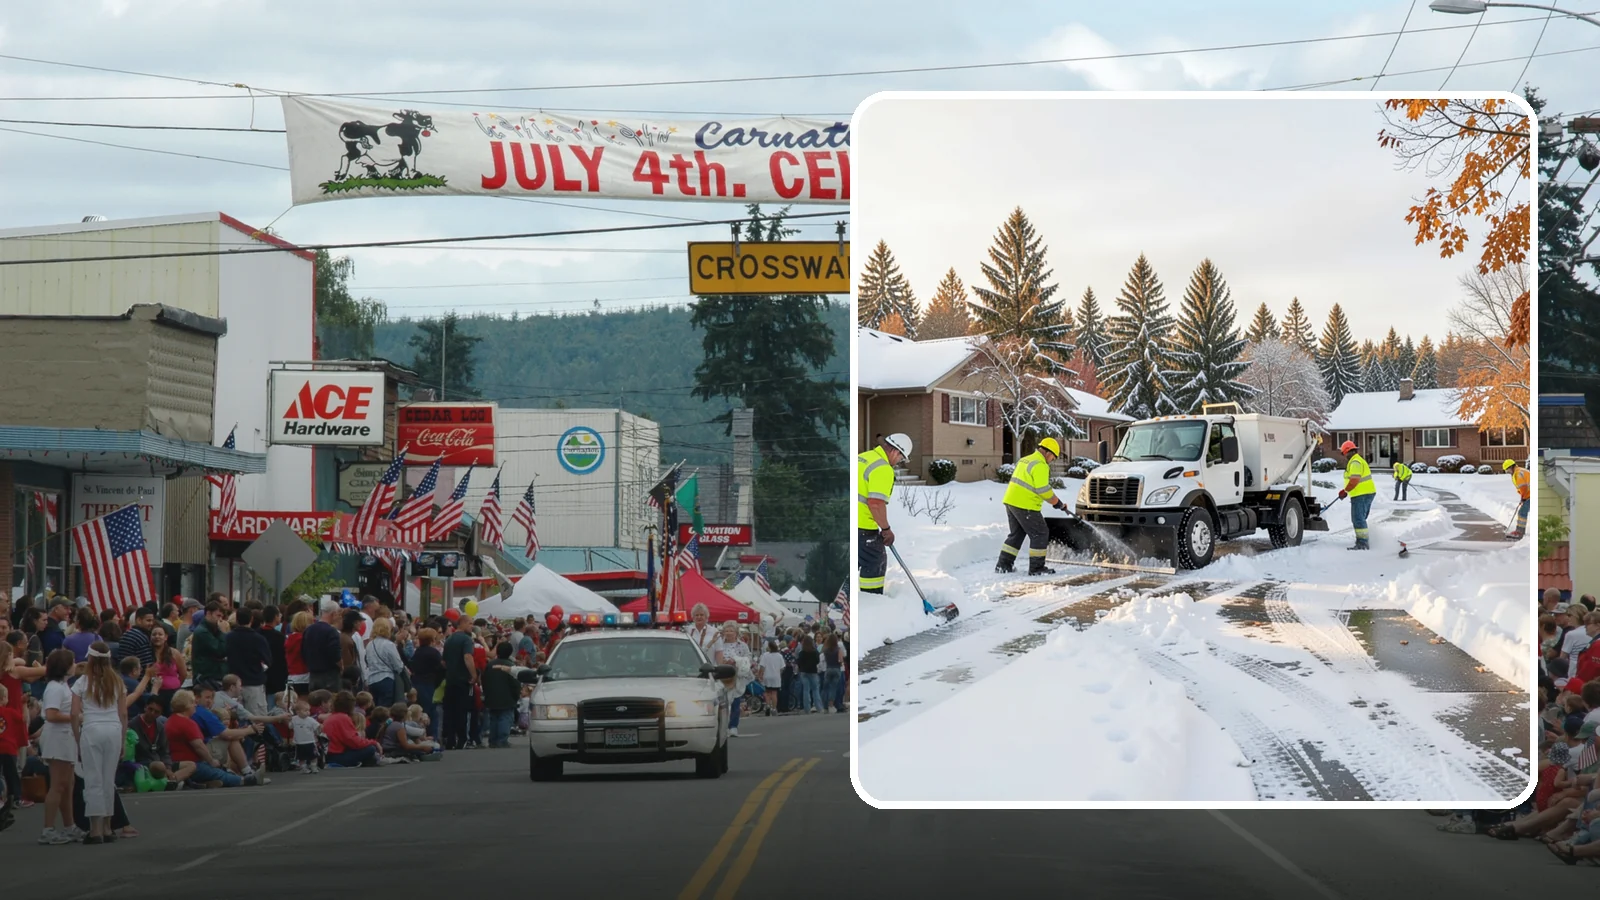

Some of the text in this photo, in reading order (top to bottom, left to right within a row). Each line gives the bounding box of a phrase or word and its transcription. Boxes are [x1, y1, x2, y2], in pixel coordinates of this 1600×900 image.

[481, 140, 605, 192] JULY
[632, 150, 746, 198] 4th.
[696, 254, 850, 280] CROSSWA
[282, 380, 373, 420] ACE
[406, 408, 452, 422] CEDAR
[283, 421, 370, 436] Hardware
[416, 428, 477, 447] Coca-Cola
[353, 467, 386, 482] Simpl
[83, 484, 155, 495] St. Vincent de Paul
[688, 527, 742, 535] CRNATION
[699, 535, 730, 543] GLASS
